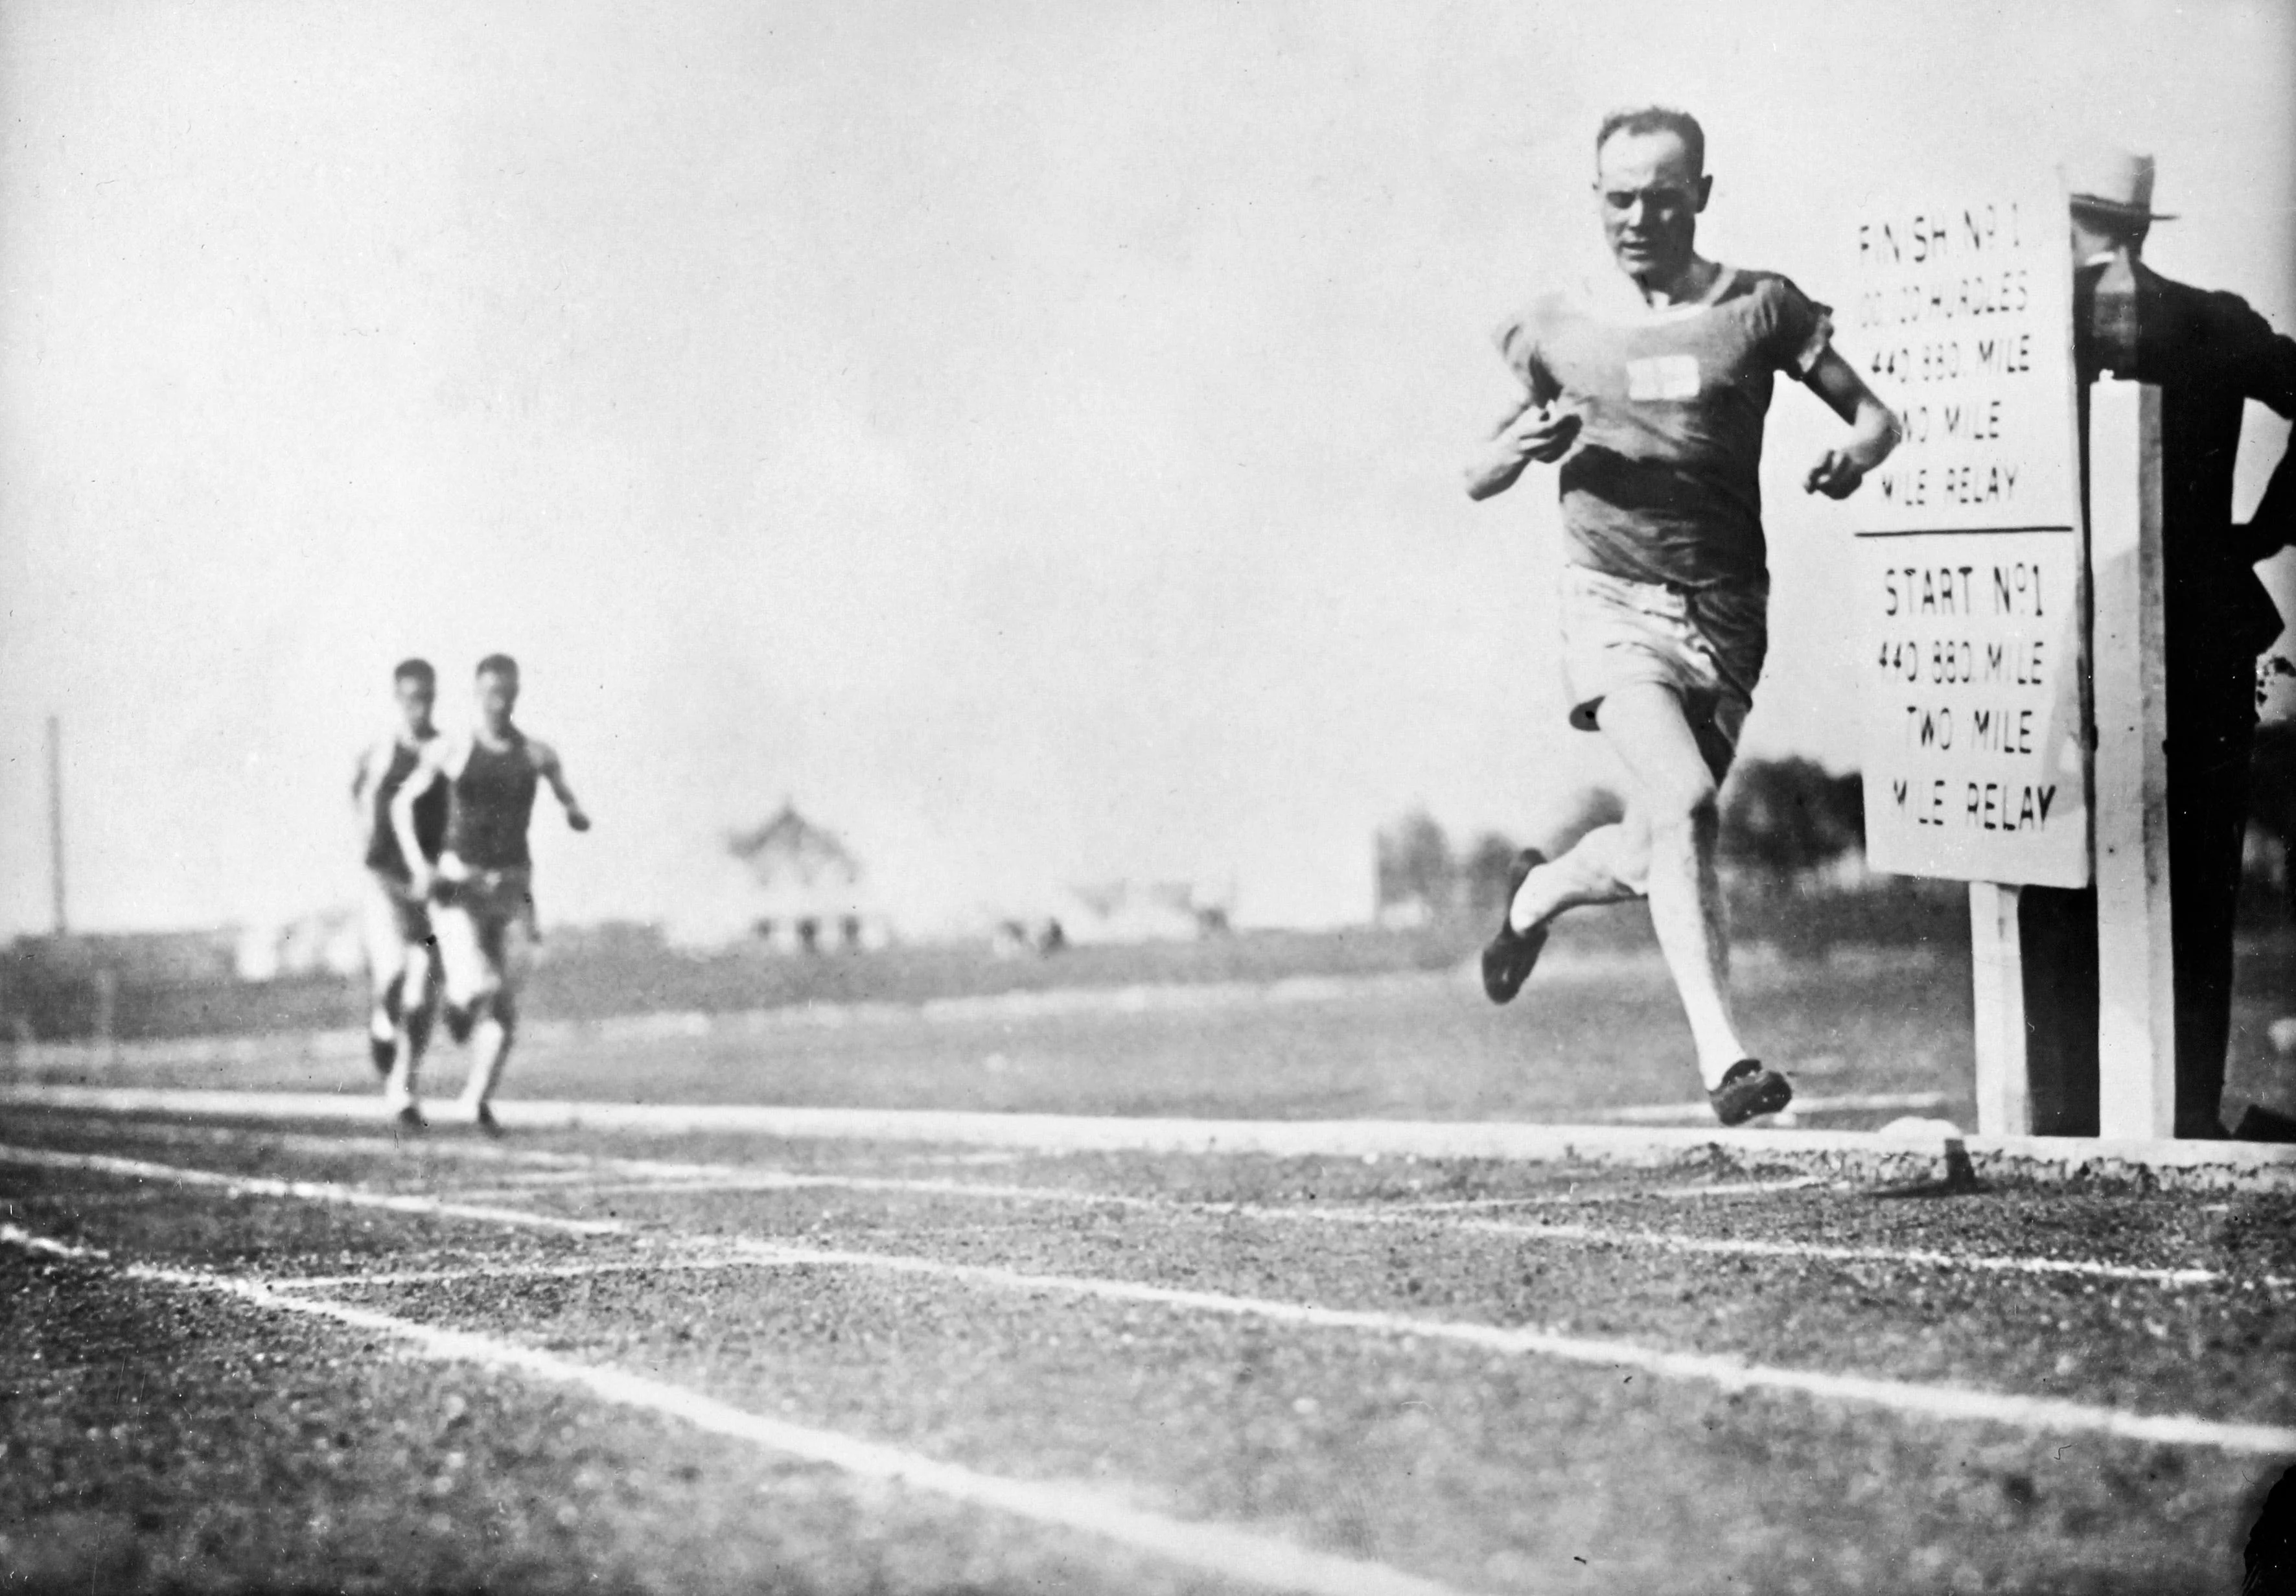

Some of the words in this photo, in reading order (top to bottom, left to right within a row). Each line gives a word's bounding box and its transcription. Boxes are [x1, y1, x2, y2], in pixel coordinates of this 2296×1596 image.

[1859, 213, 1947, 264] FNSH
[1882, 468, 1927, 507] MLE
[1946, 465, 2019, 506] RELAY
[1884, 566, 1973, 616] START
[1879, 641, 1918, 682] 440
[1985, 641, 2044, 685] MILE
[1907, 705, 1953, 750] TWO
[1971, 709, 2033, 754] MILE
[1893, 779, 1945, 826] MLE
[1966, 781, 2056, 832] RELAY
